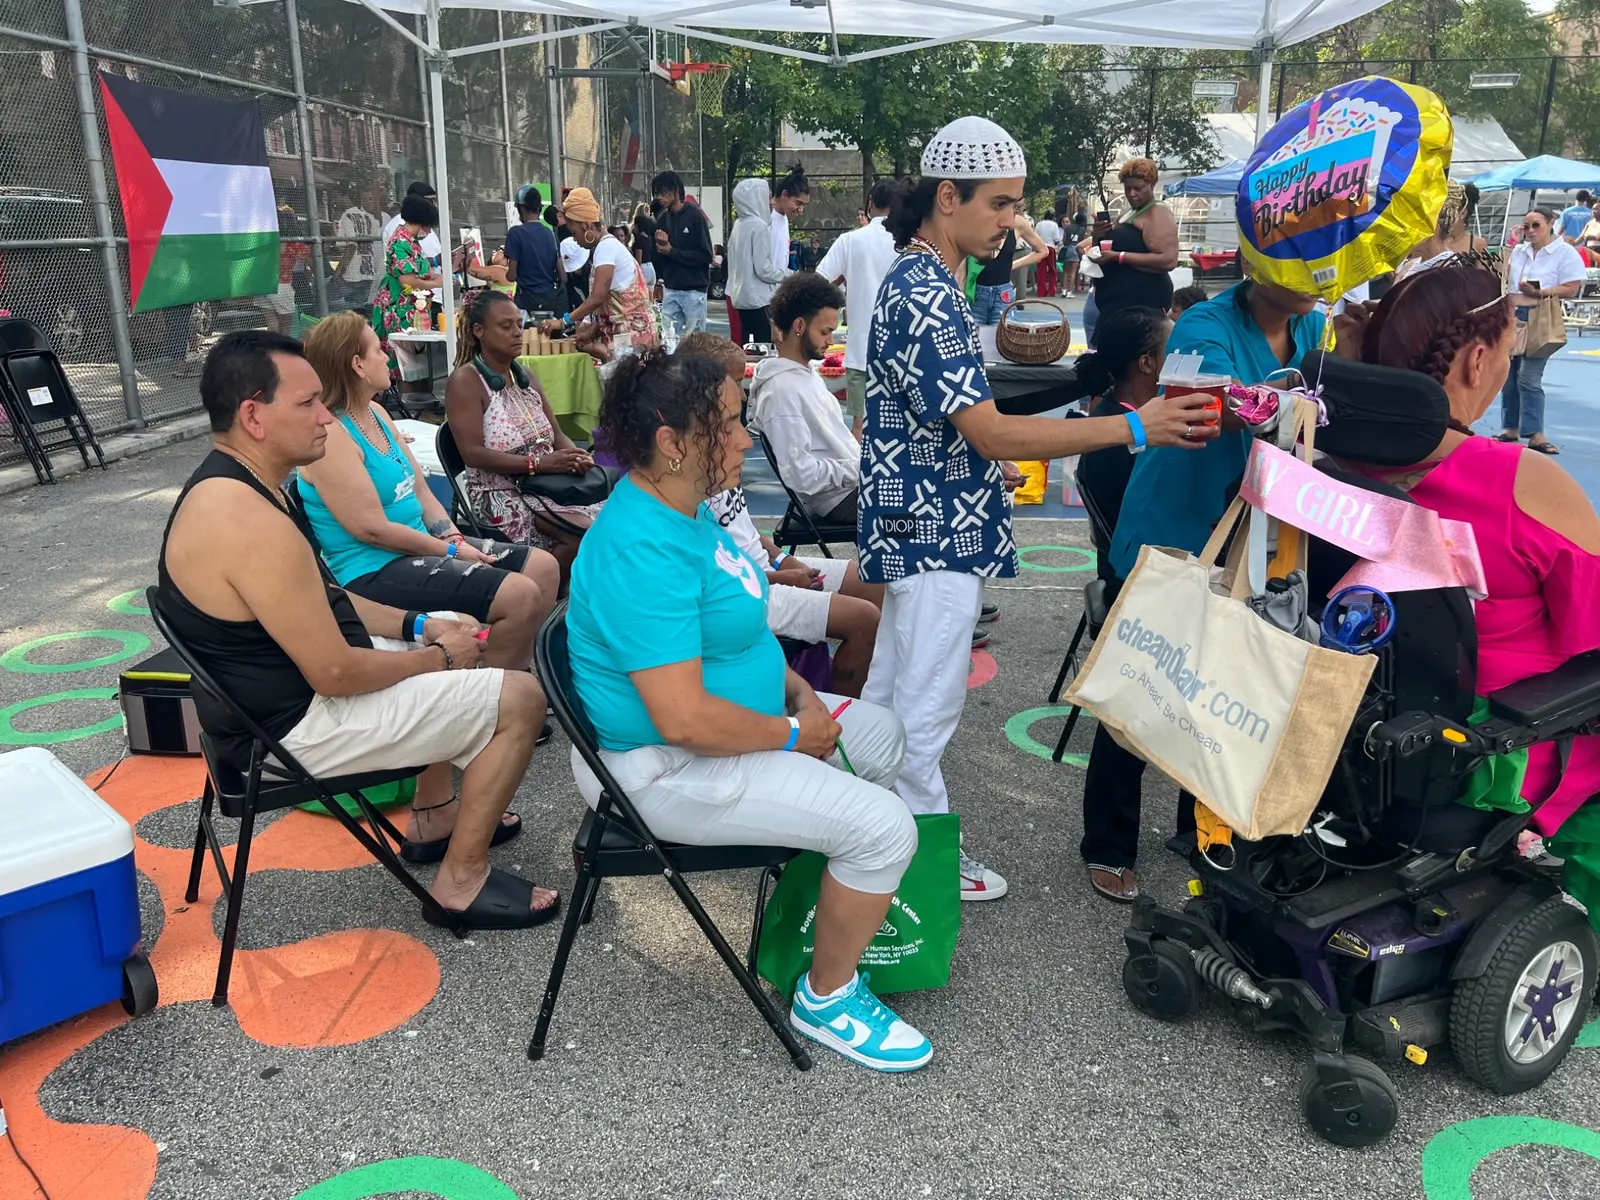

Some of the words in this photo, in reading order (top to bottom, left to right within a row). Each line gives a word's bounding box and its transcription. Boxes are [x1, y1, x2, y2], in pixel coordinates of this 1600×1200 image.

[1254, 160, 1369, 240] Birthday
[1255, 157, 1310, 201] Happy
[885, 519, 914, 533] DIOP
[1296, 481, 1376, 546] GIRL
[1120, 663, 1136, 679] Go
[1137, 672, 1163, 711] Ahead,
[1163, 702, 1176, 723] Be
[1178, 717, 1223, 755] Cheap
[901, 903, 921, 925] Center
